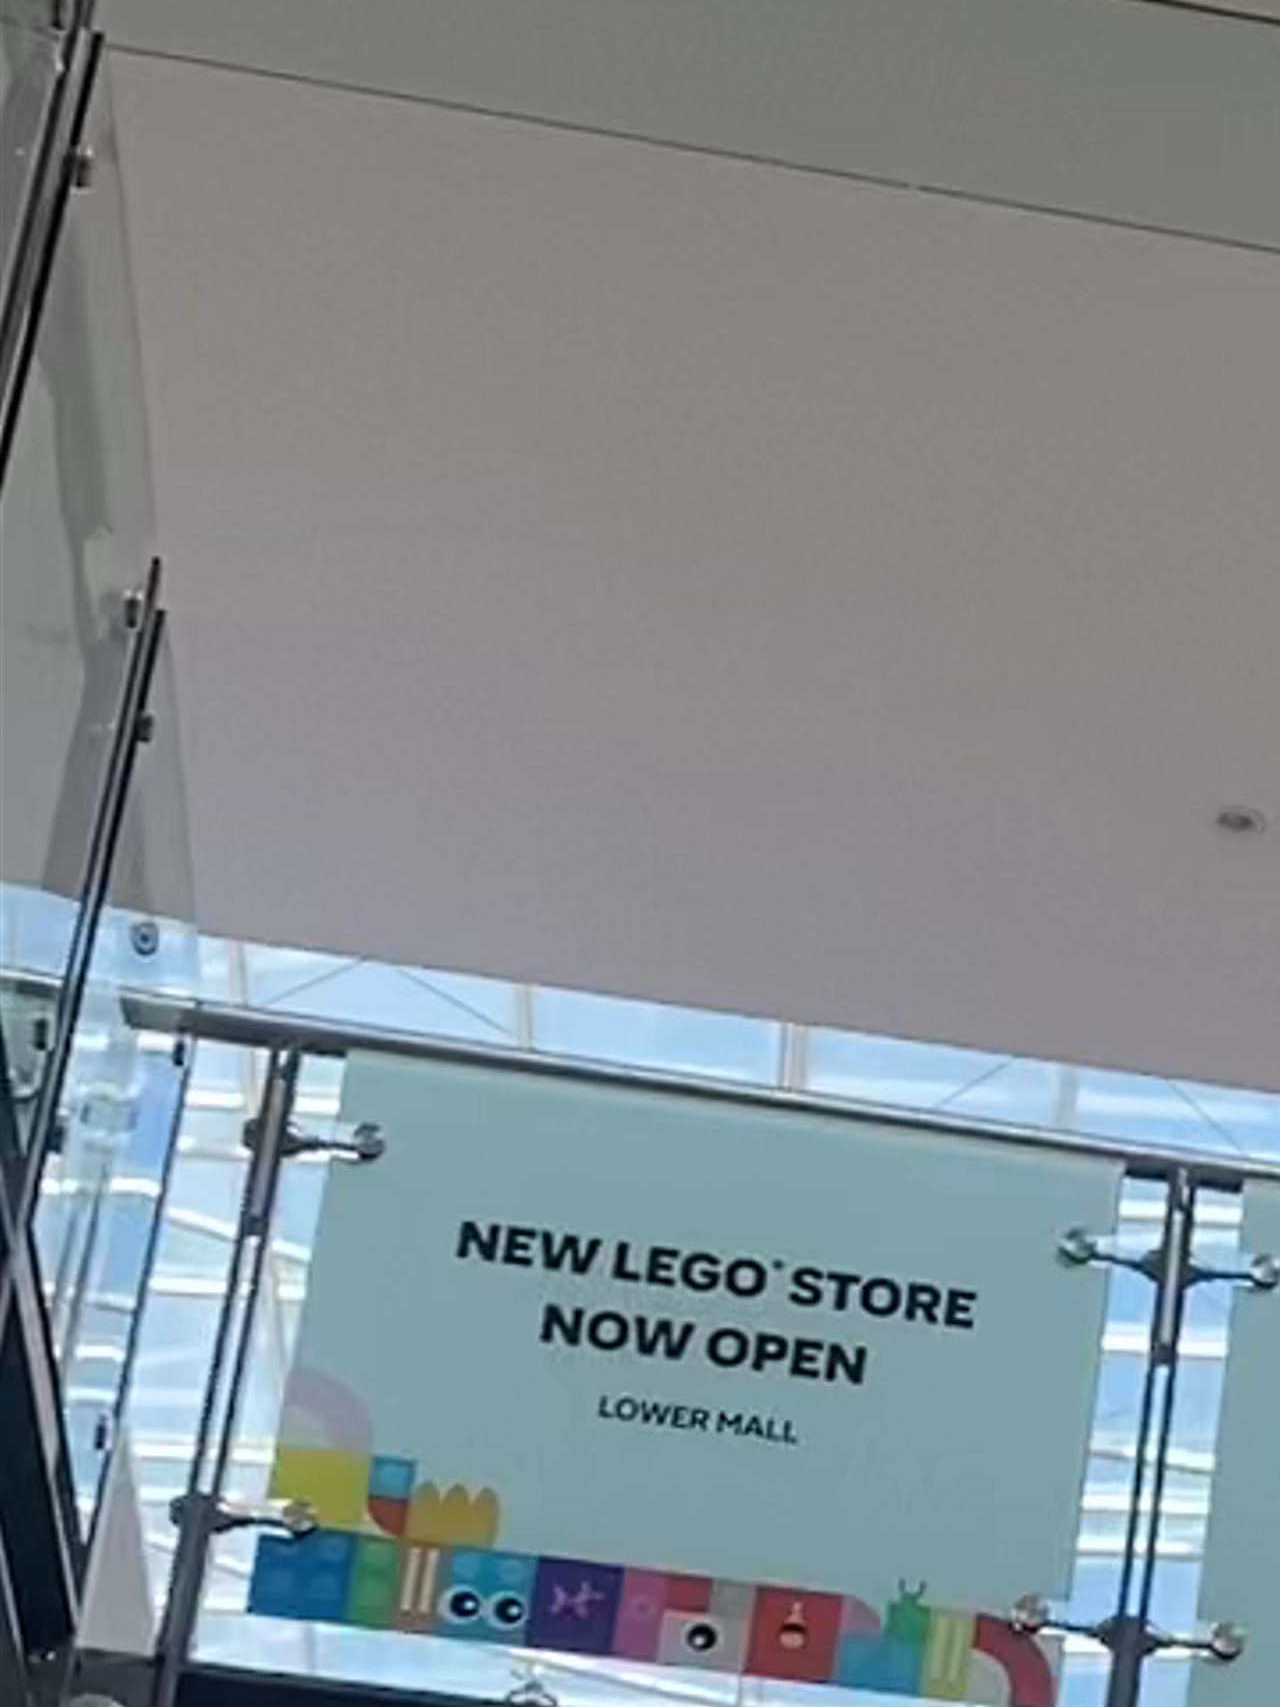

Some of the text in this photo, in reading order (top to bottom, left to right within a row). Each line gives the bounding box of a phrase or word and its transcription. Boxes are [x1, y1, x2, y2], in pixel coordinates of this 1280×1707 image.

[456, 1219, 603, 1276] NEW
[788, 1266, 979, 1330] STORE
[539, 1302, 868, 1386] NOW OPEN
[597, 1395, 798, 1446] LOWER MALL
